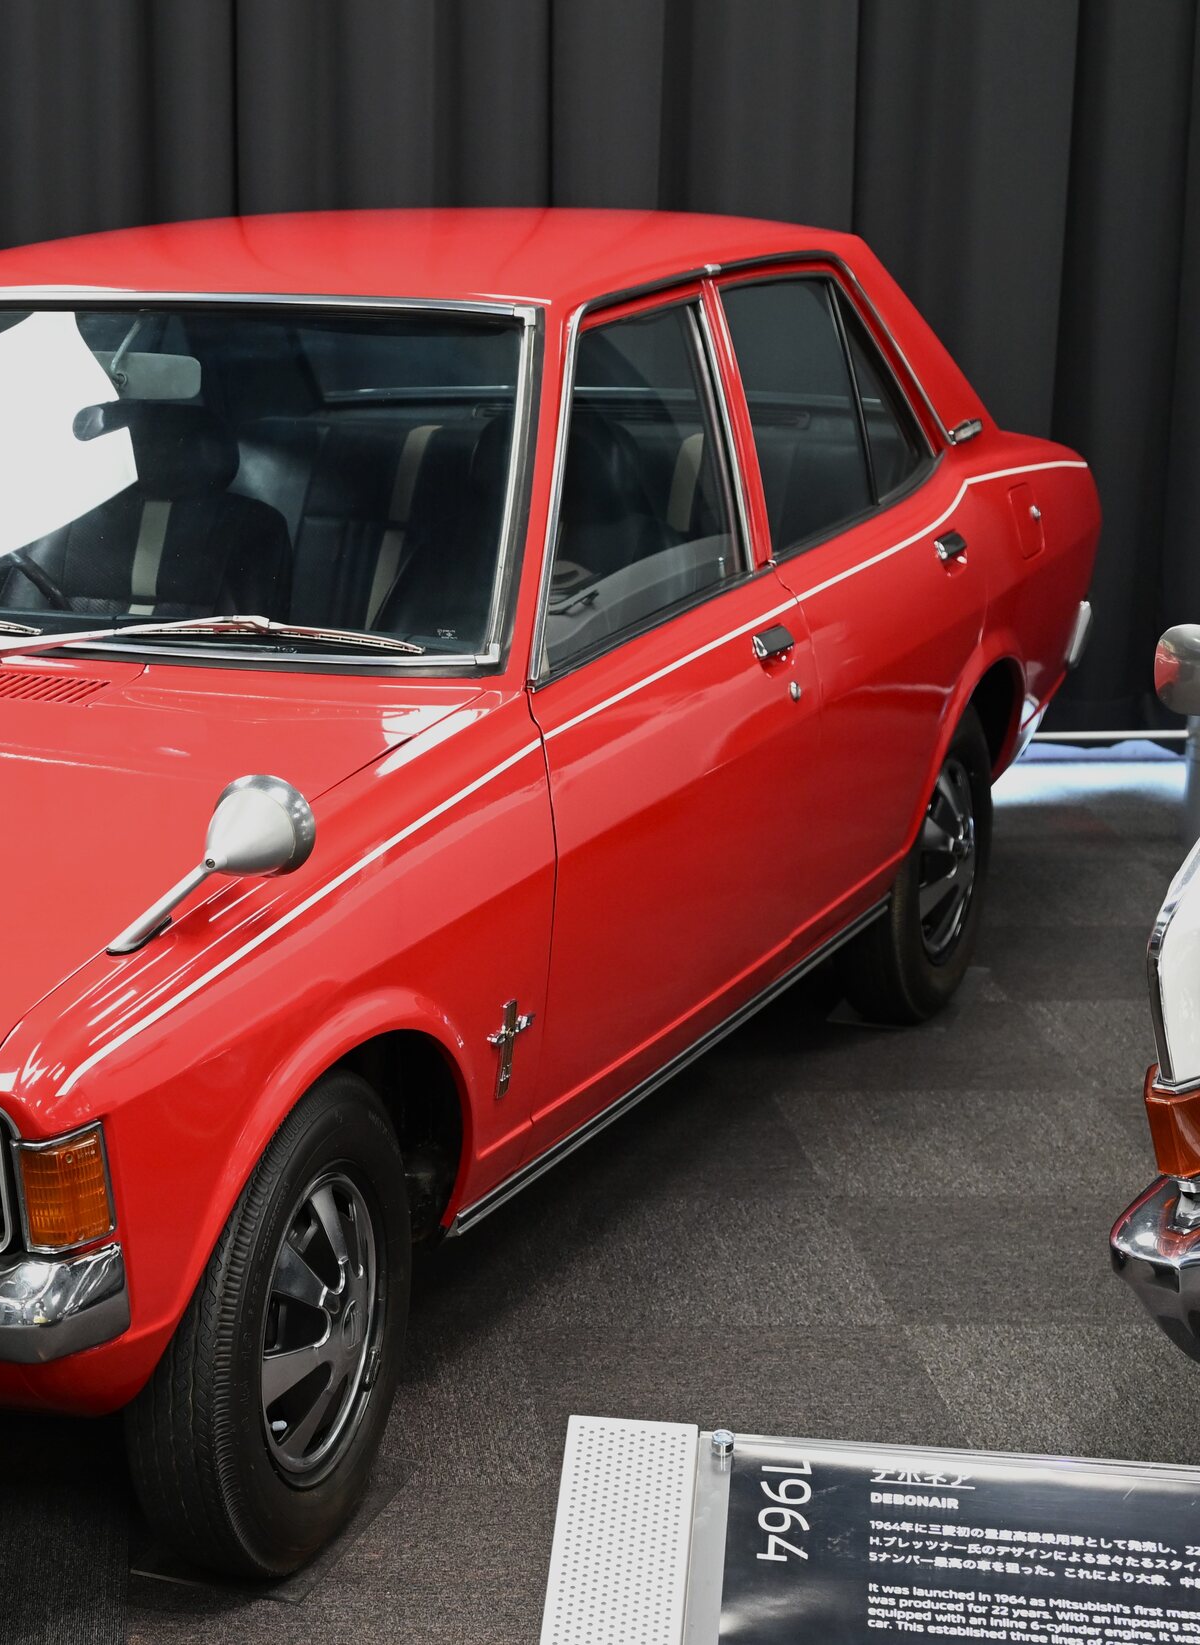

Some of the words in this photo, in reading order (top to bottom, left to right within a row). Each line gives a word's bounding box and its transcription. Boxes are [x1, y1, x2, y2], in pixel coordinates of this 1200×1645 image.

[756, 1460, 812, 1562] 1964
[870, 1492, 959, 1509] DEBONAIR
[869, 1536, 1200, 1572] H.ブレッツナー氏のデザインによる堂々たるスタイ
[868, 1582, 879, 1593] It
[881, 1585, 910, 1595] was
[913, 1586, 975, 1601] launched
[978, 1592, 991, 1602] in
[994, 1593, 1027, 1605] 1964
[1029, 1597, 1046, 1607] as
[1049, 1598, 1131, 1614] Mitsubishi's
[1133, 1604, 1164, 1617] first
[868, 1595, 896, 1606] was
[899, 1598, 964, 1611] produced
[967, 1603, 988, 1614] for
[991, 1605, 1009, 1615] 22
[1012, 1608, 1053, 1620] years.
[1056, 1610, 1089, 1623] With
[1092, 1615, 1110, 1624] an
[1114, 1615, 1179, 1632] imposing
[867, 1607, 931, 1621] equipped
[935, 1612, 966, 1624] with
[969, 1616, 986, 1626] an
[990, 1617, 1027, 1630] inline
[1030, 1621, 1101, 1635] 6-cylinder
[1104, 1627, 1156, 1642] engine,
[1159, 1631, 1170, 1642] It
[867, 1618, 893, 1629] car.
[896, 1620, 924, 1633] This
[927, 1624, 1007, 1640] established
[1009, 1631, 1048, 1644] three
[1051, 1635, 1084, 1645] lines
